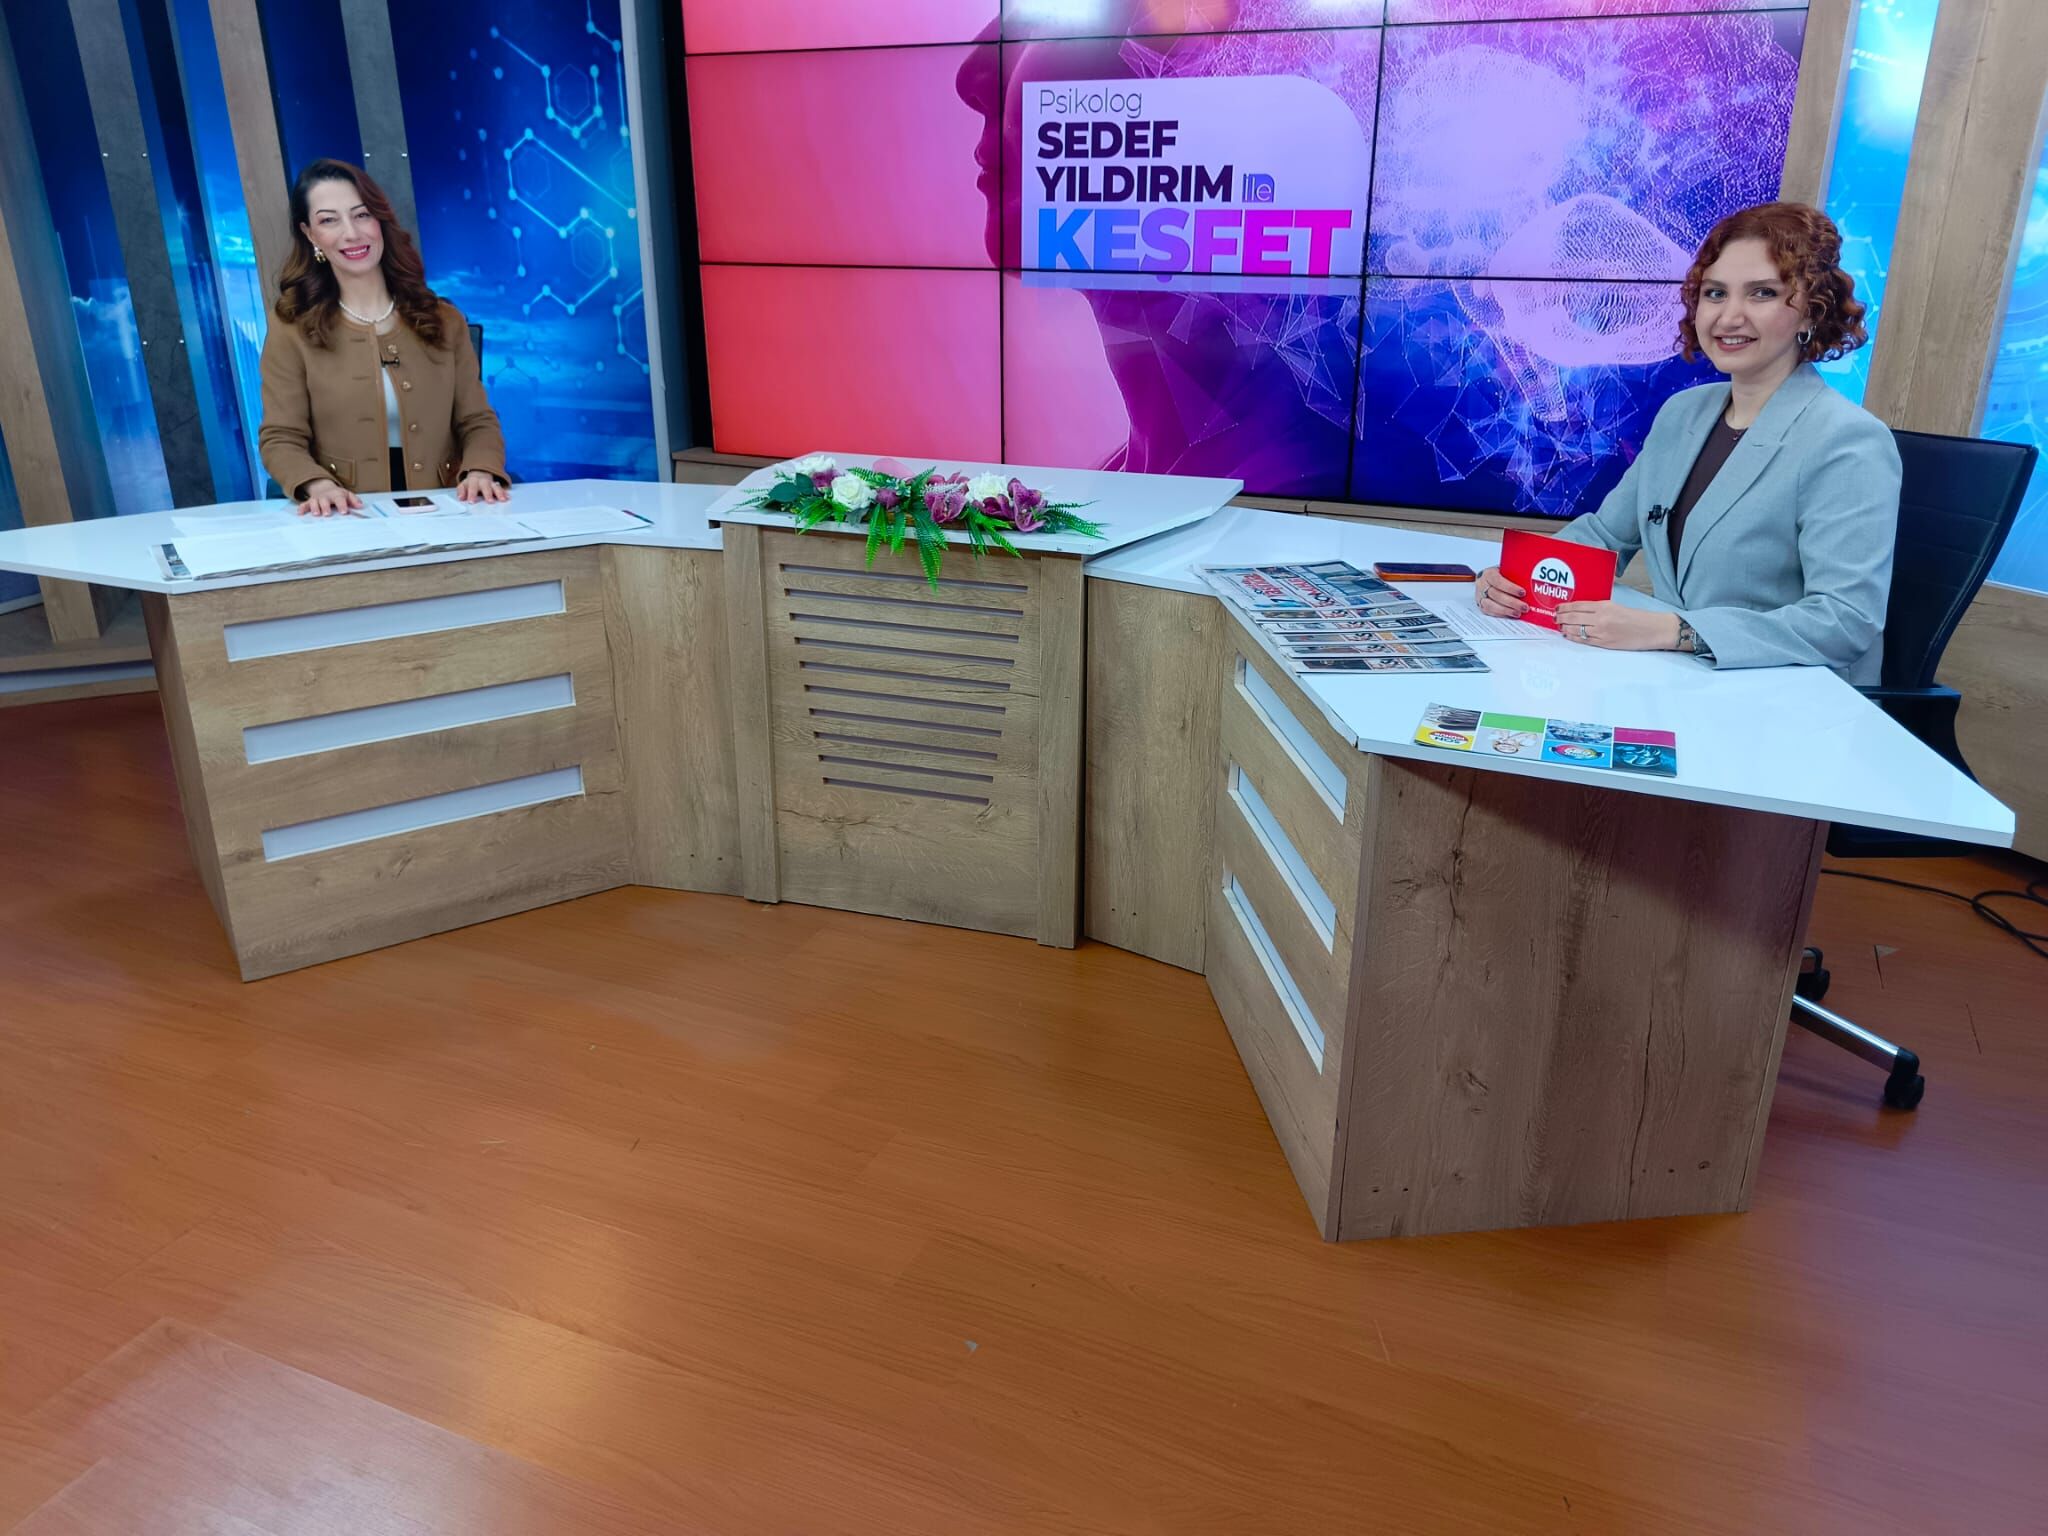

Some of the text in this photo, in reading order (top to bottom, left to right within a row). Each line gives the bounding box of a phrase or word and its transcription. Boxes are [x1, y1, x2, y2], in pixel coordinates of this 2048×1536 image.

[1039, 88, 1142, 118] Psikolog
[1037, 120, 1179, 159] SEDEF
[1036, 165, 1274, 203] YILDIRIM ile
[1038, 208, 1352, 282] KEŞFET
[1534, 582, 1568, 600] MÜHÜR
[1539, 566, 1568, 584] SON
